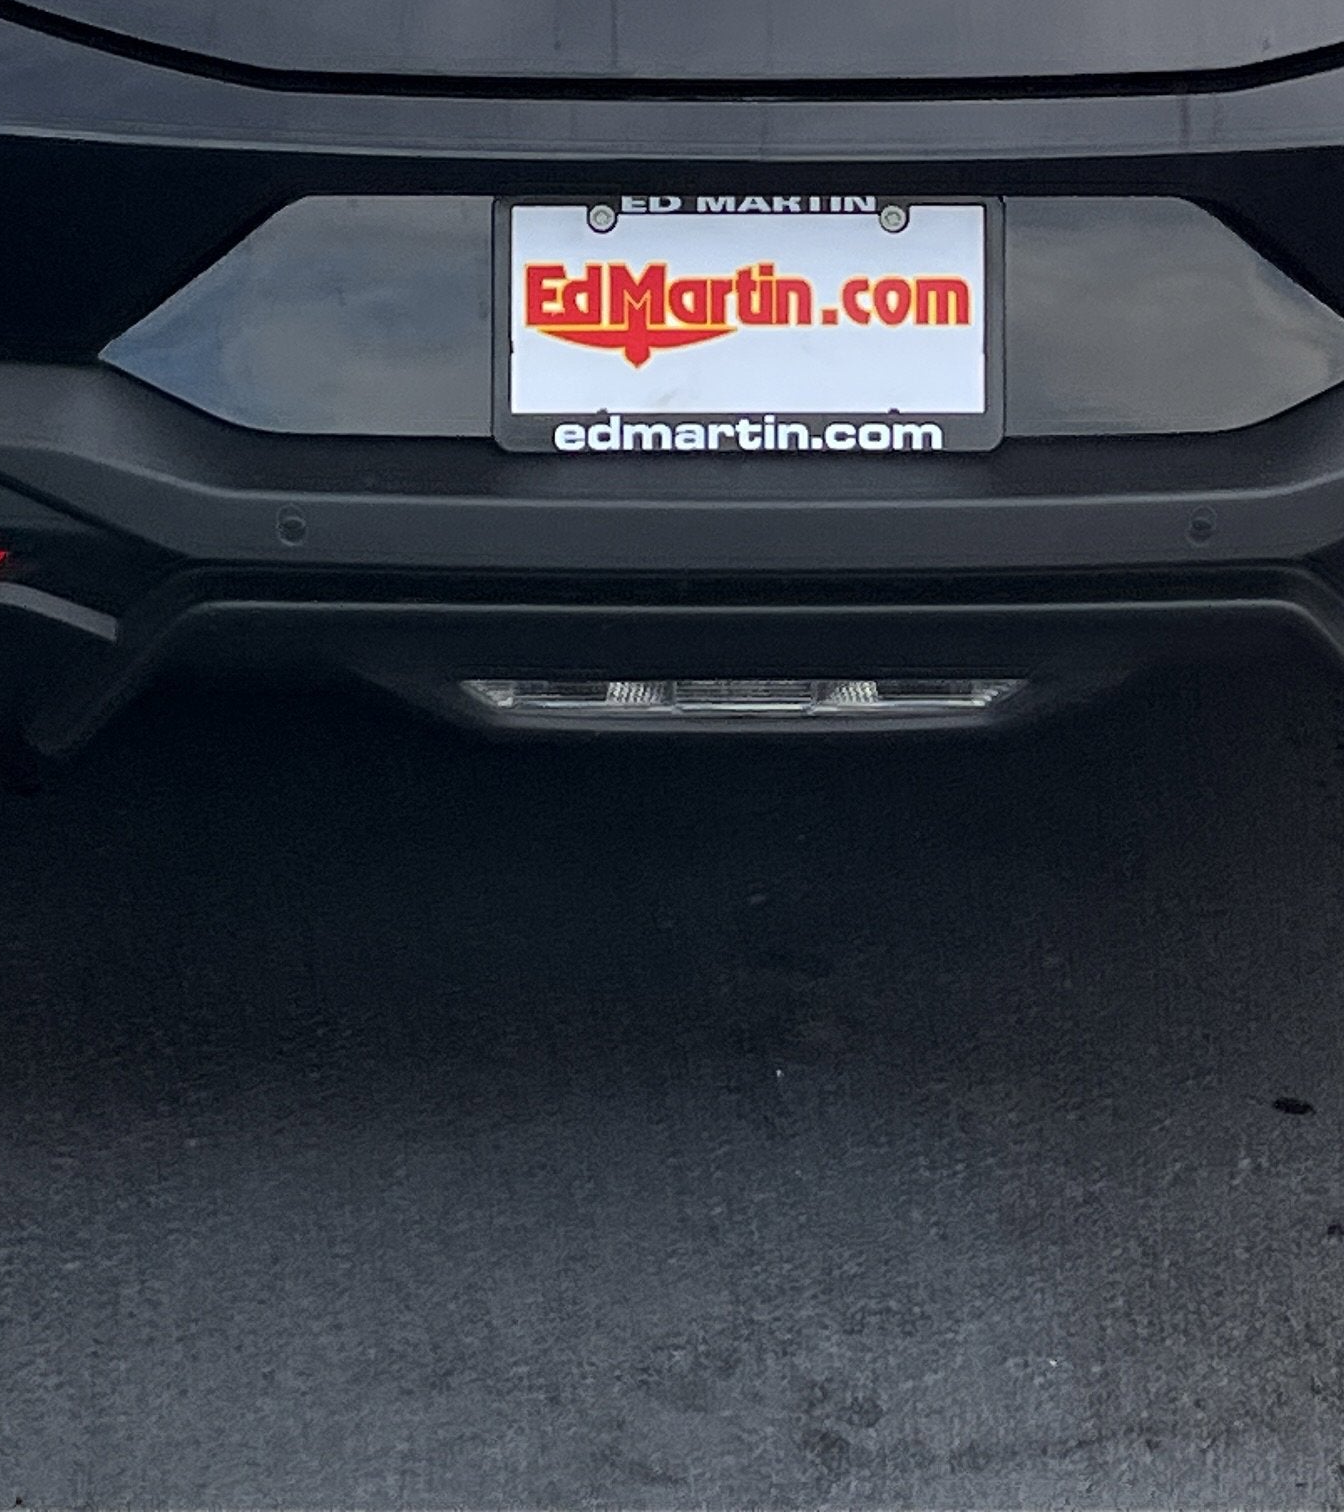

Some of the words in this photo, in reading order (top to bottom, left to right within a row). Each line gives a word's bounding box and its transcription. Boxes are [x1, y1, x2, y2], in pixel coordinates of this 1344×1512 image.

[621, 195, 682, 213] ED
[523, 261, 972, 367] EdMartin.com
[554, 414, 943, 451] edmartin.com
